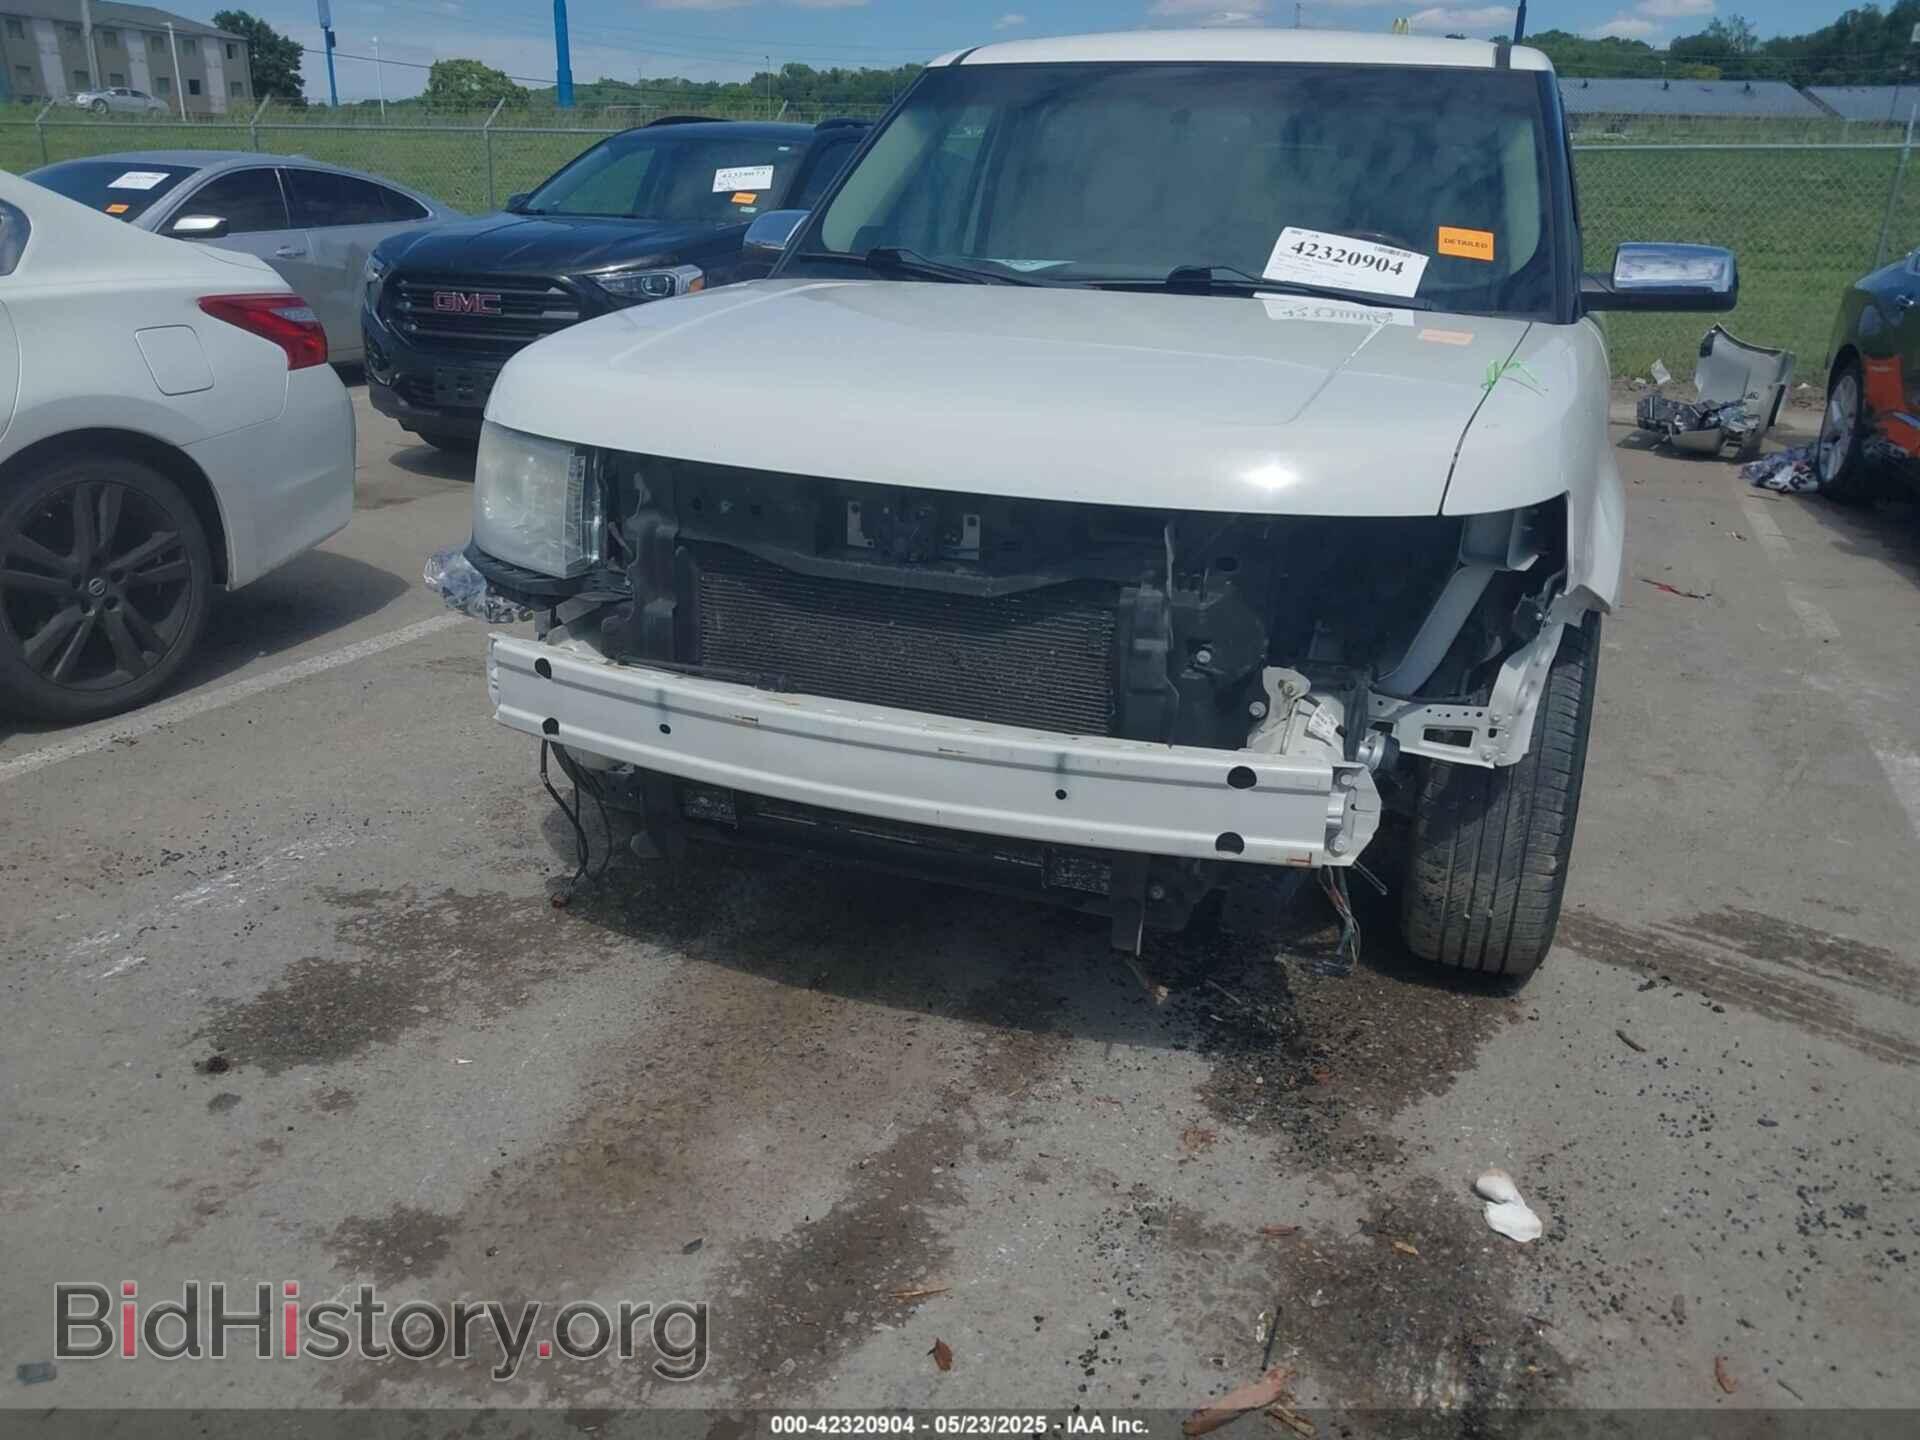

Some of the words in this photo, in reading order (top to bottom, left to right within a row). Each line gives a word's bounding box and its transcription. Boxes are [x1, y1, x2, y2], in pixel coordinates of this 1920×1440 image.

[1443, 237, 1489, 249] DETAILED
[1290, 240, 1404, 276] 42320904
[432, 290, 502, 315] GMC
